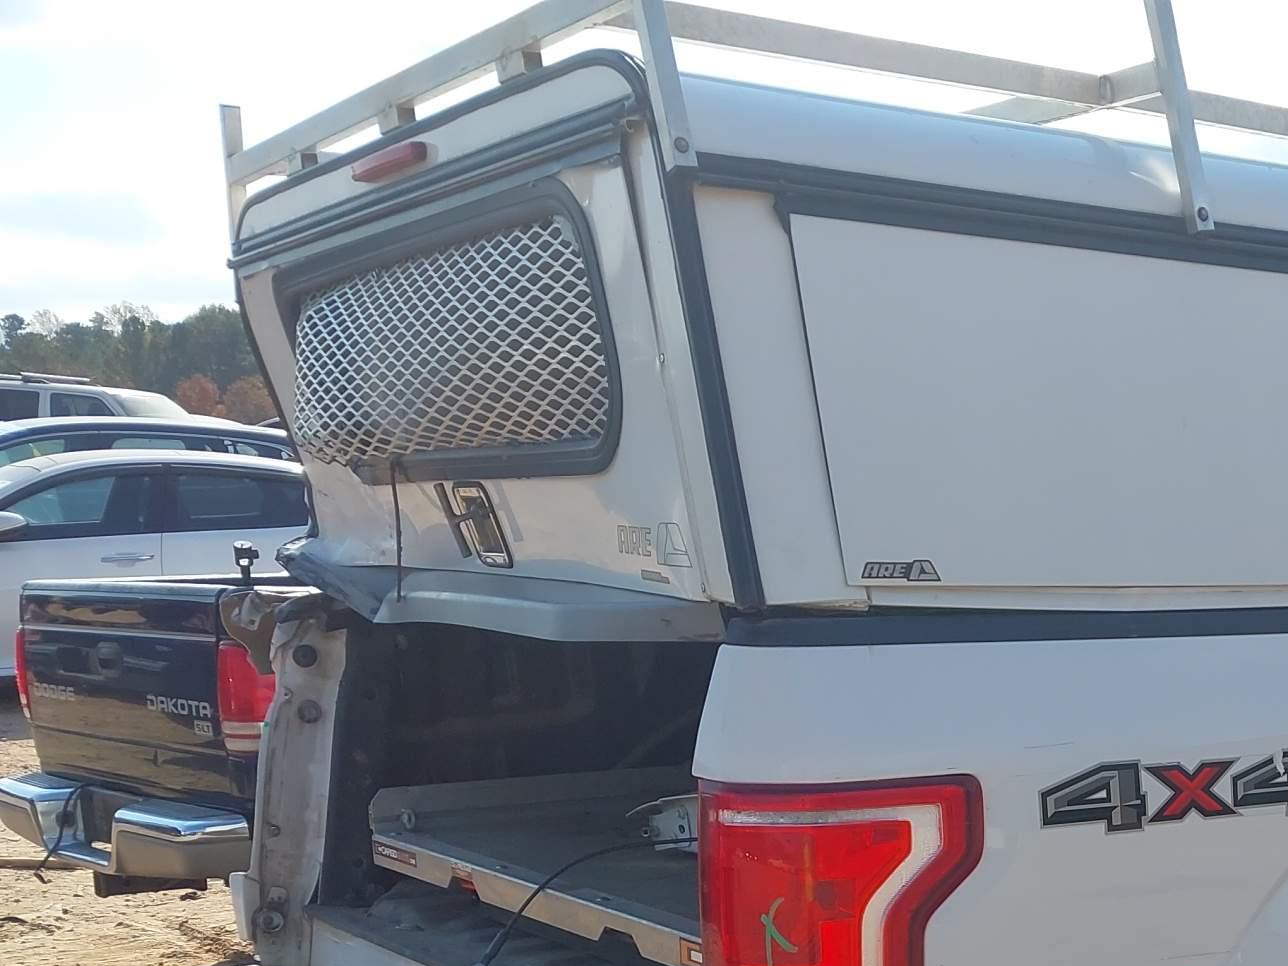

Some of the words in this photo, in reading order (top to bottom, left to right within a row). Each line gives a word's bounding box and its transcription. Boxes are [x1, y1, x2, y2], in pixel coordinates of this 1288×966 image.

[616, 524, 652, 557] ARE
[862, 562, 911, 579] ARE
[146, 695, 212, 718] DAKOTA
